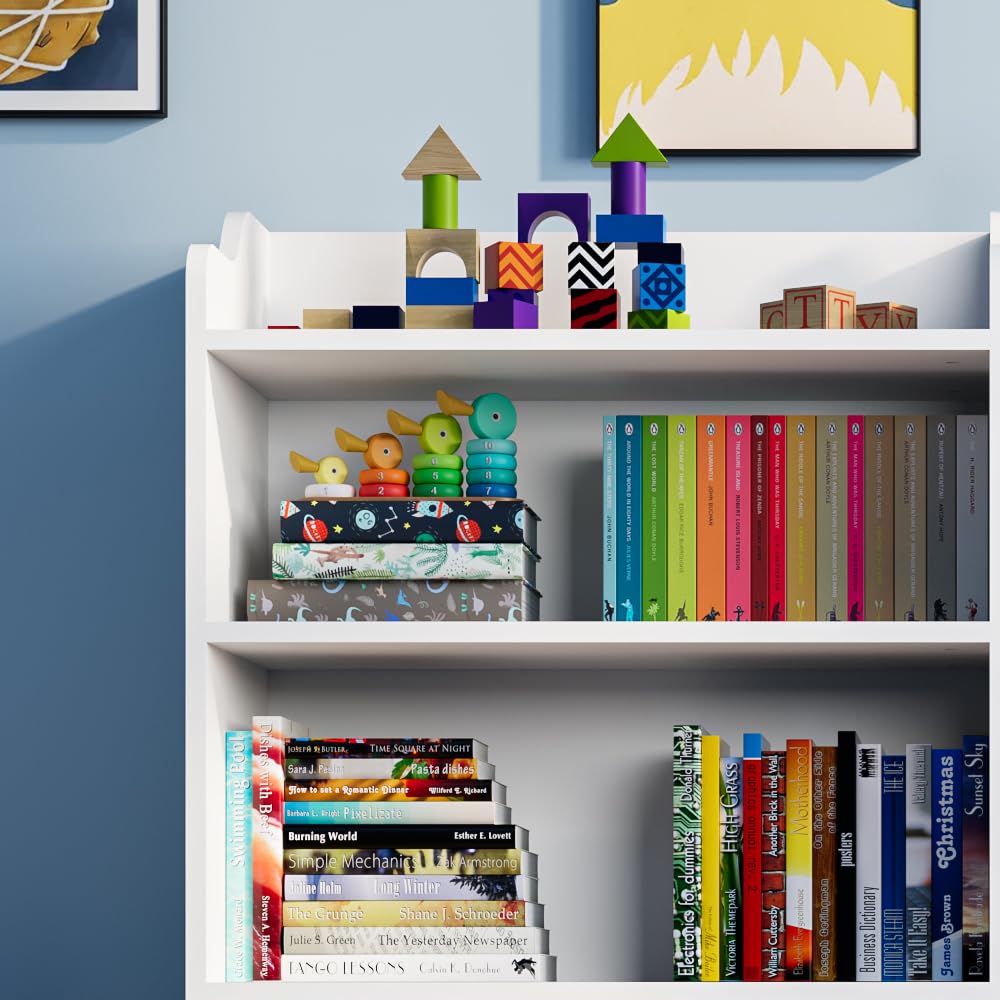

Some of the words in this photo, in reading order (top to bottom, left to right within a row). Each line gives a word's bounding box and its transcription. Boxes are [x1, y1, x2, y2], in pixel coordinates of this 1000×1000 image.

[433, 472, 438, 480] 5
[486, 487, 491, 495] 7
[230, 735, 245, 773] Pool
[370, 744, 392, 752] TIME
[394, 744, 427, 752] SQUARE
[429, 744, 439, 752] AT
[441, 744, 471, 752] NIGHT
[964, 743, 987, 769] Sky
[288, 764, 307, 775] Sara
[411, 764, 440, 775] Pasta
[442, 764, 475, 775] dishes
[769, 755, 778, 773] Wall
[884, 761, 904, 774] ICE
[259, 772, 273, 799] with
[309, 786, 318, 795] to
[680, 768, 693, 801] Donald
[747, 764, 758, 810] graphics
[769, 775, 778, 790] the
[792, 746, 809, 836] Motherhood
[884, 777, 904, 793] THE
[769, 800, 778, 821] Brick
[936, 756, 956, 869] Christmas
[230, 780, 249, 867] Swimming
[289, 832, 326, 843] Burning
[328, 832, 358, 843] World
[454, 832, 475, 840] Esther
[478, 832, 486, 840] E.
[488, 832, 512, 840] Lovett
[769, 822, 778, 856] Another
[814, 835, 822, 849] On
[678, 831, 695, 884] dummies
[841, 832, 855, 867] posters
[289, 854, 337, 872] Simple
[342, 854, 417, 872] Mechanics
[459, 856, 518, 870] Armstrong
[320, 880, 342, 895] Holm
[403, 879, 441, 898] Winter
[678, 888, 695, 905] for
[261, 895, 271, 921] Steven
[288, 907, 311, 922] The
[315, 907, 364, 922] Grunge
[400, 908, 438, 921] Shane
[455, 908, 519, 921] Schroeder
[860, 886, 880, 931] Dictionary
[261, 923, 271, 933] A.
[768, 905, 780, 945] Cuttersby
[884, 908, 904, 940] STEAM
[908, 907, 930, 936] Easy!
[289, 934, 311, 946] Julie
[326, 934, 356, 946] Green
[378, 934, 399, 947] The
[402, 934, 459, 947] Yesterday
[464, 934, 528, 947] Newspaper
[678, 910, 695, 976] Electronics
[768, 946, 780, 977] William
[860, 933, 880, 972] Business
[884, 942, 904, 977] MONICA
[908, 947, 927, 976] Take
